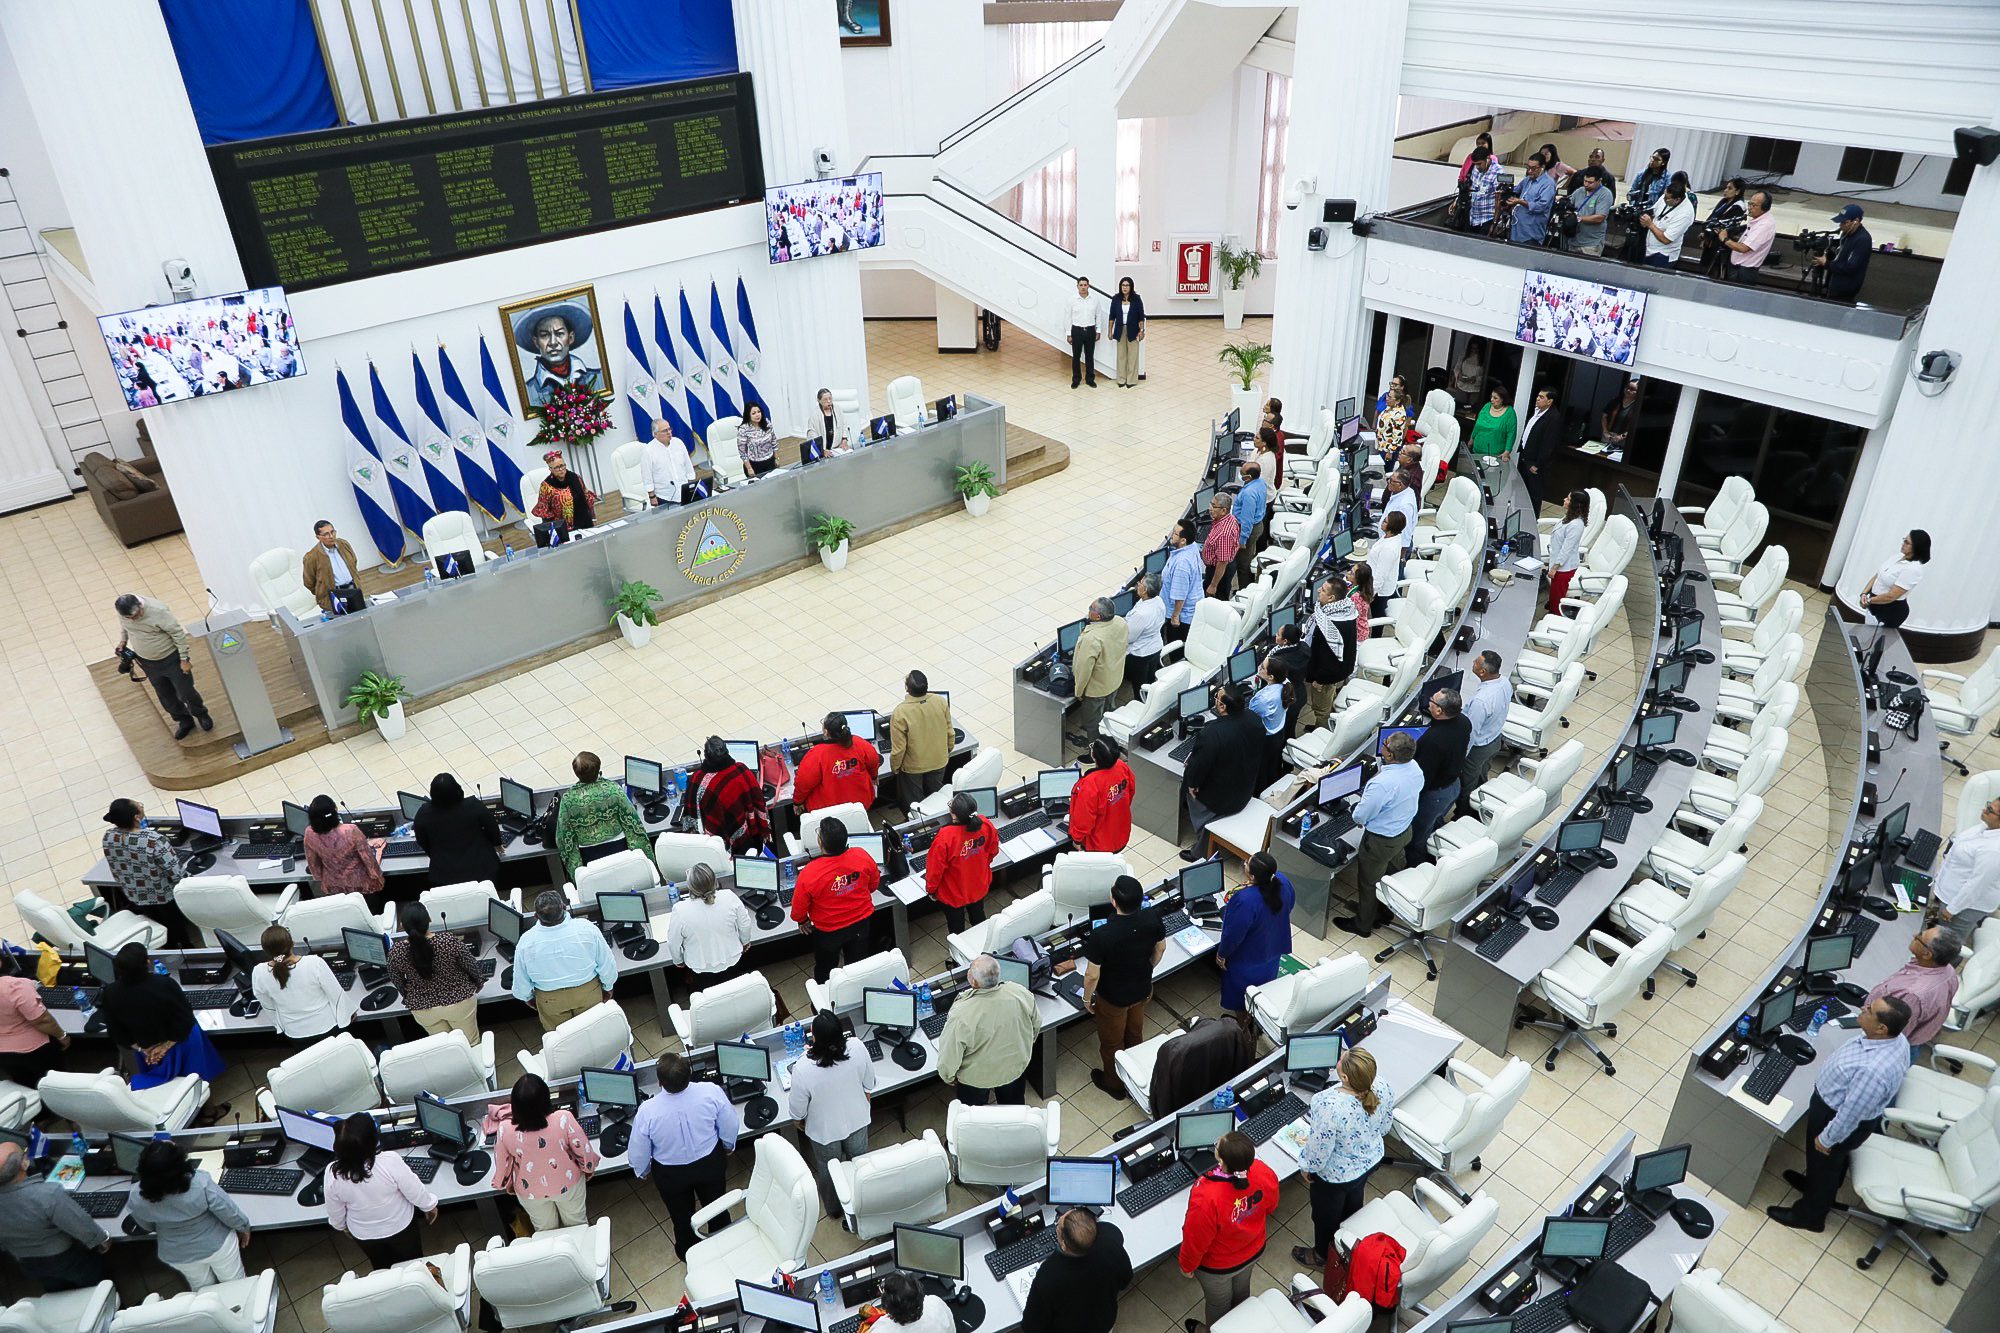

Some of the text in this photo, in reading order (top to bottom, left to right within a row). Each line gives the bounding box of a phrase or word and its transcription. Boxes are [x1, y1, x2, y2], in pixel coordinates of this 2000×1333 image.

[413, 124, 440, 135] SESION
[1179, 283, 1208, 291] EXTINTOR
[675, 507, 748, 565] REPUBLICA DE NICARAGUA
[682, 548, 747, 585] AMERICA CENTRAL
